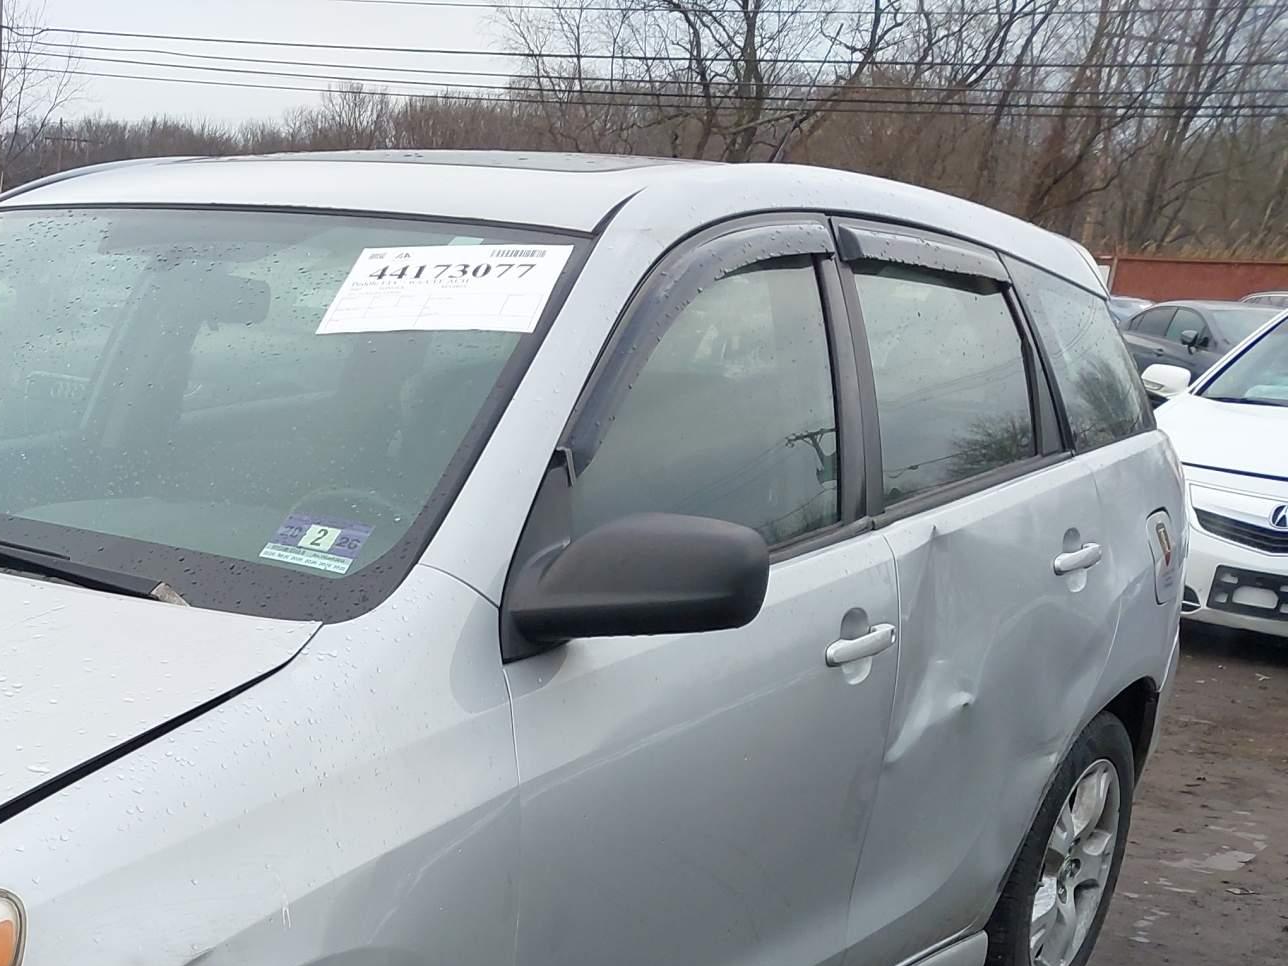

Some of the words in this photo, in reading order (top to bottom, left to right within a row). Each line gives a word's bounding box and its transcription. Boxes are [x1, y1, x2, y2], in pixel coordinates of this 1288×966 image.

[368, 263, 537, 280] 44173077
[310, 528, 329, 547] 2
[335, 536, 361, 550] 26
